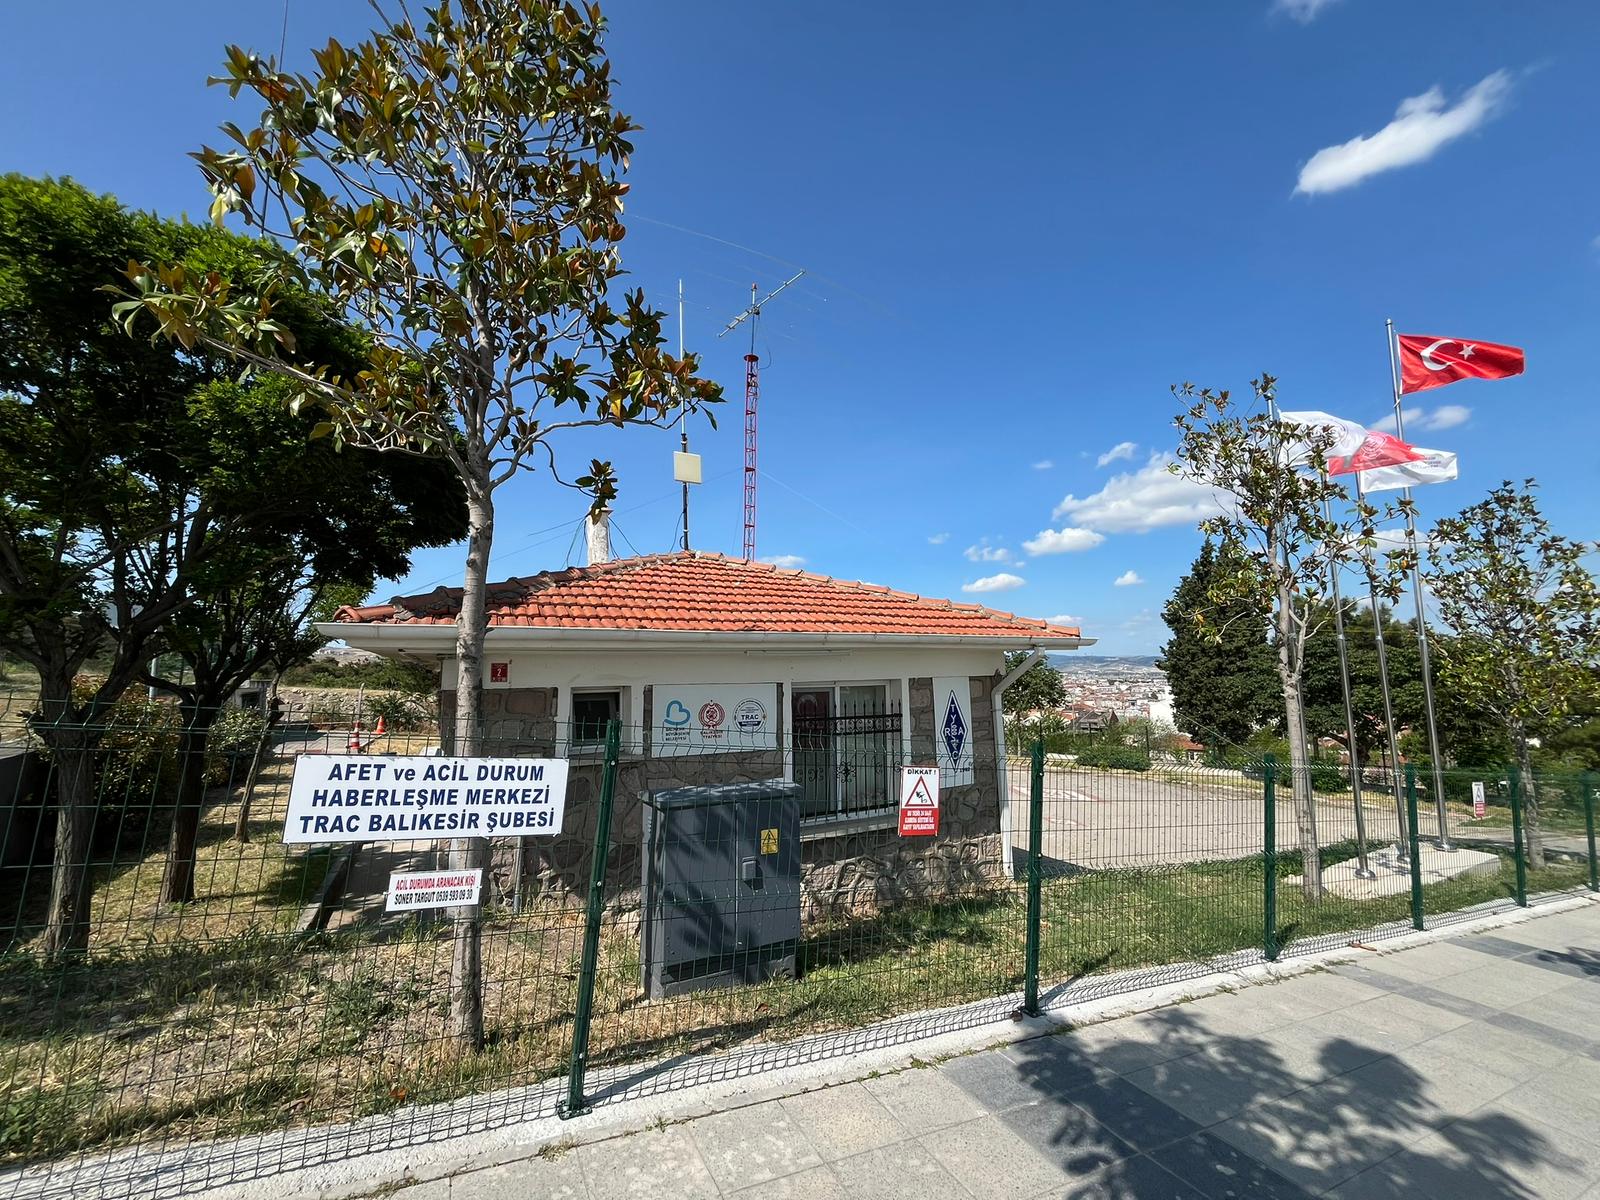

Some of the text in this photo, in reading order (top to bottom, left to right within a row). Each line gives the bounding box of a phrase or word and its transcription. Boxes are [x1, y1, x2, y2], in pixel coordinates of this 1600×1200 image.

[328, 761, 544, 781] AFET ve ACİL DURUM
[312, 785, 549, 810] HABERLEŞME MERKEZİ
[300, 807, 554, 833] TRAC BALIKESİR ŞUBESİ
[396, 873, 476, 891] ACİL DURUMDA ARANACAK KİŞİ
[394, 889, 473, 905] SONER TARGUT 0539 593 09 30
